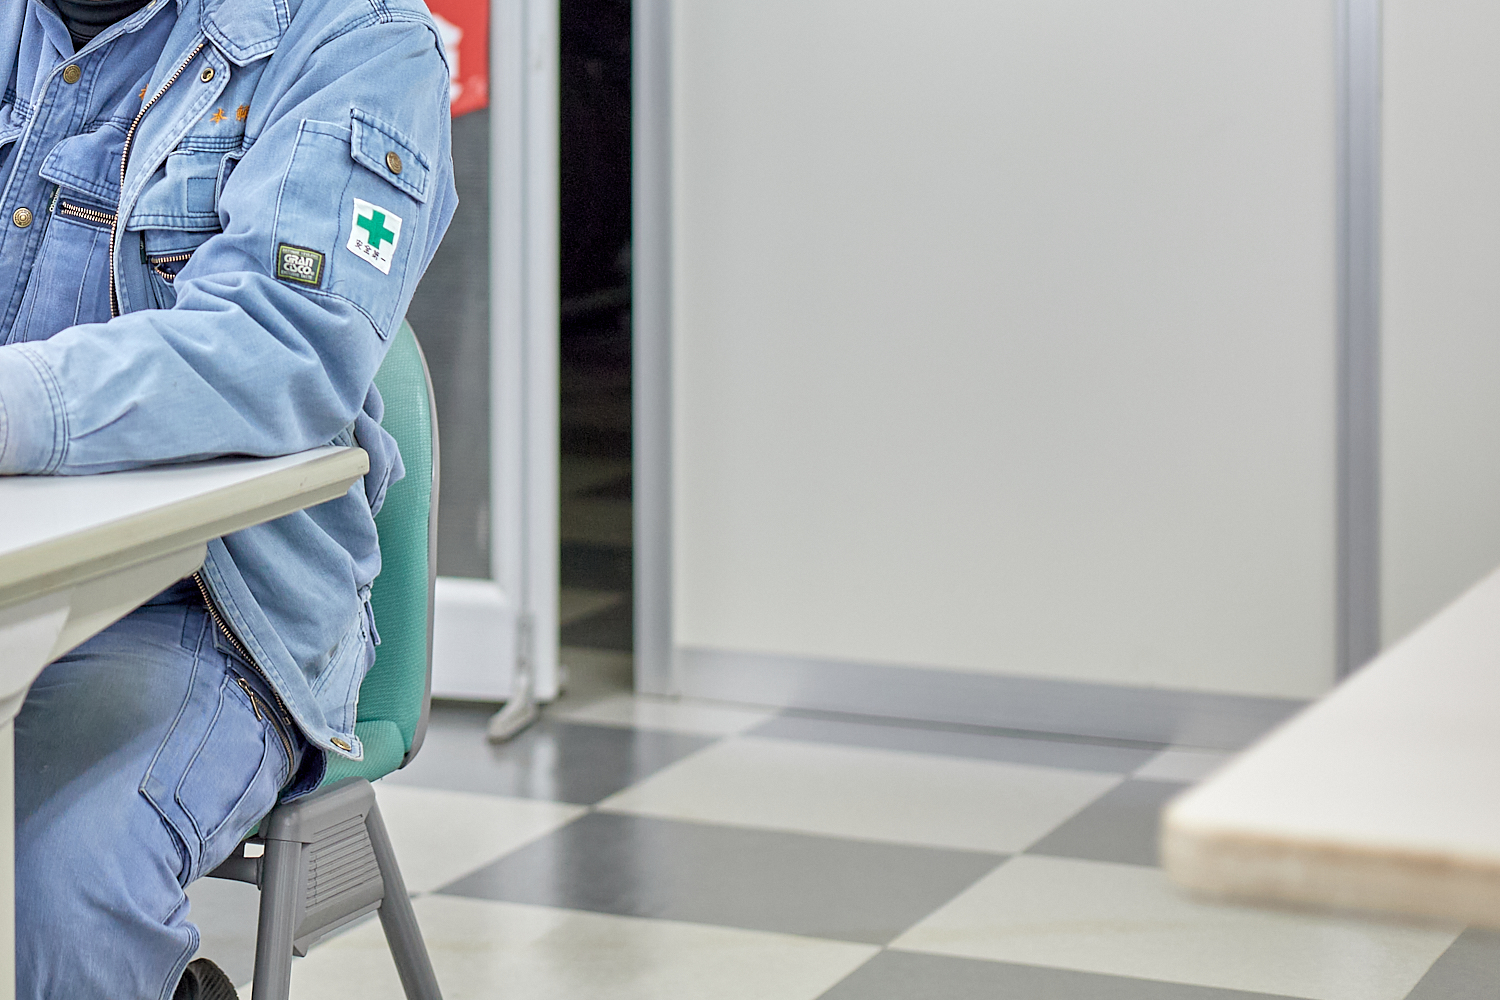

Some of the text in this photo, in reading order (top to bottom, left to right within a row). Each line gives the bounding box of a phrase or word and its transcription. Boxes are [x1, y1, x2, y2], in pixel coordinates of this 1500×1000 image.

[354, 239, 387, 262] 安全第一
[283, 253, 314, 267] GRAN
